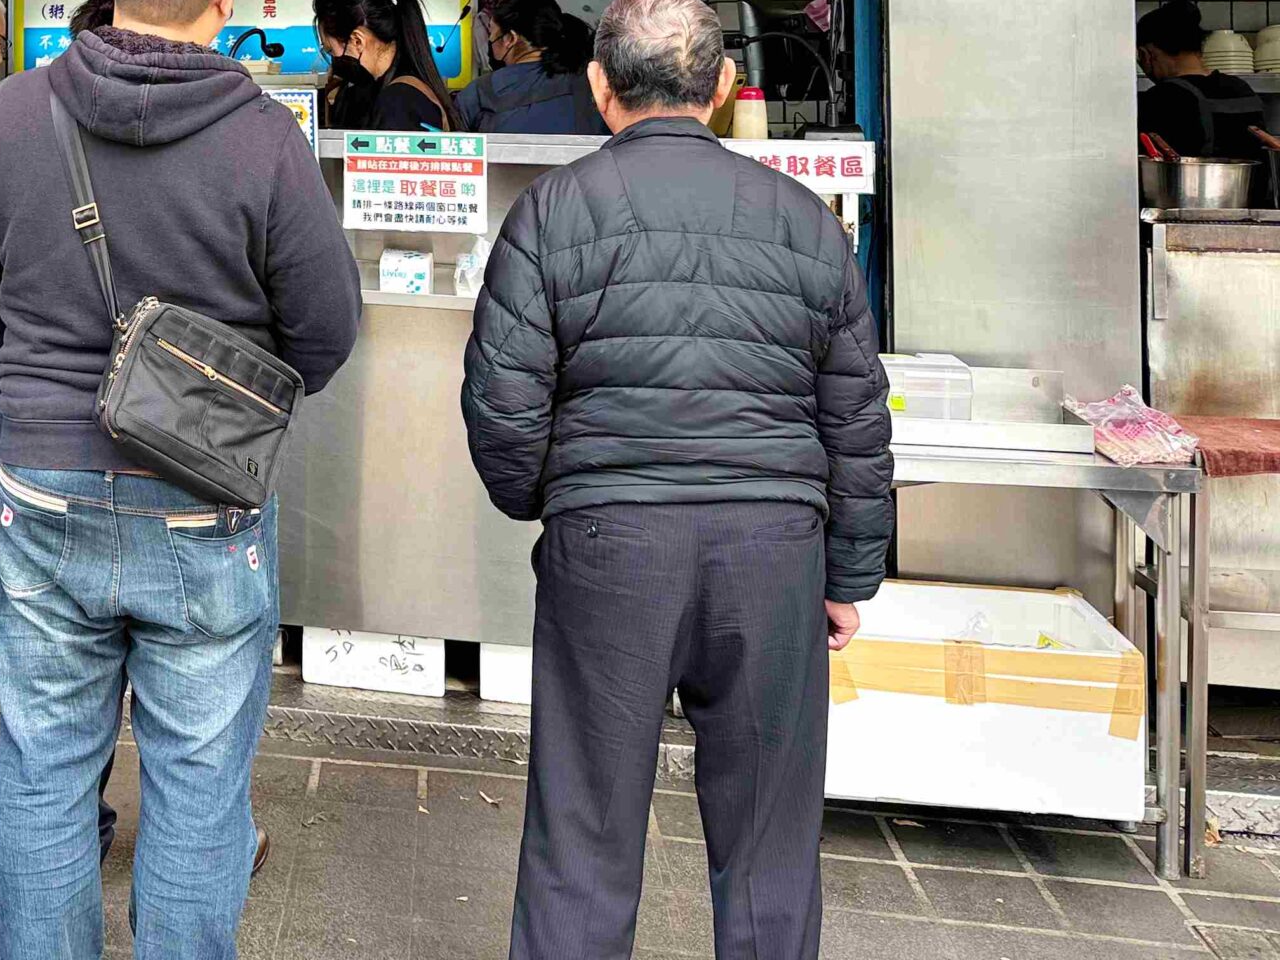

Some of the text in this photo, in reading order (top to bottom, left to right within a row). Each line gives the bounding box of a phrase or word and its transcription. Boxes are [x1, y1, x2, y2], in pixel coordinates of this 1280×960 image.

[375, 136, 477, 155] 點餐 點餐
[400, 179, 457, 197] 取餐區
